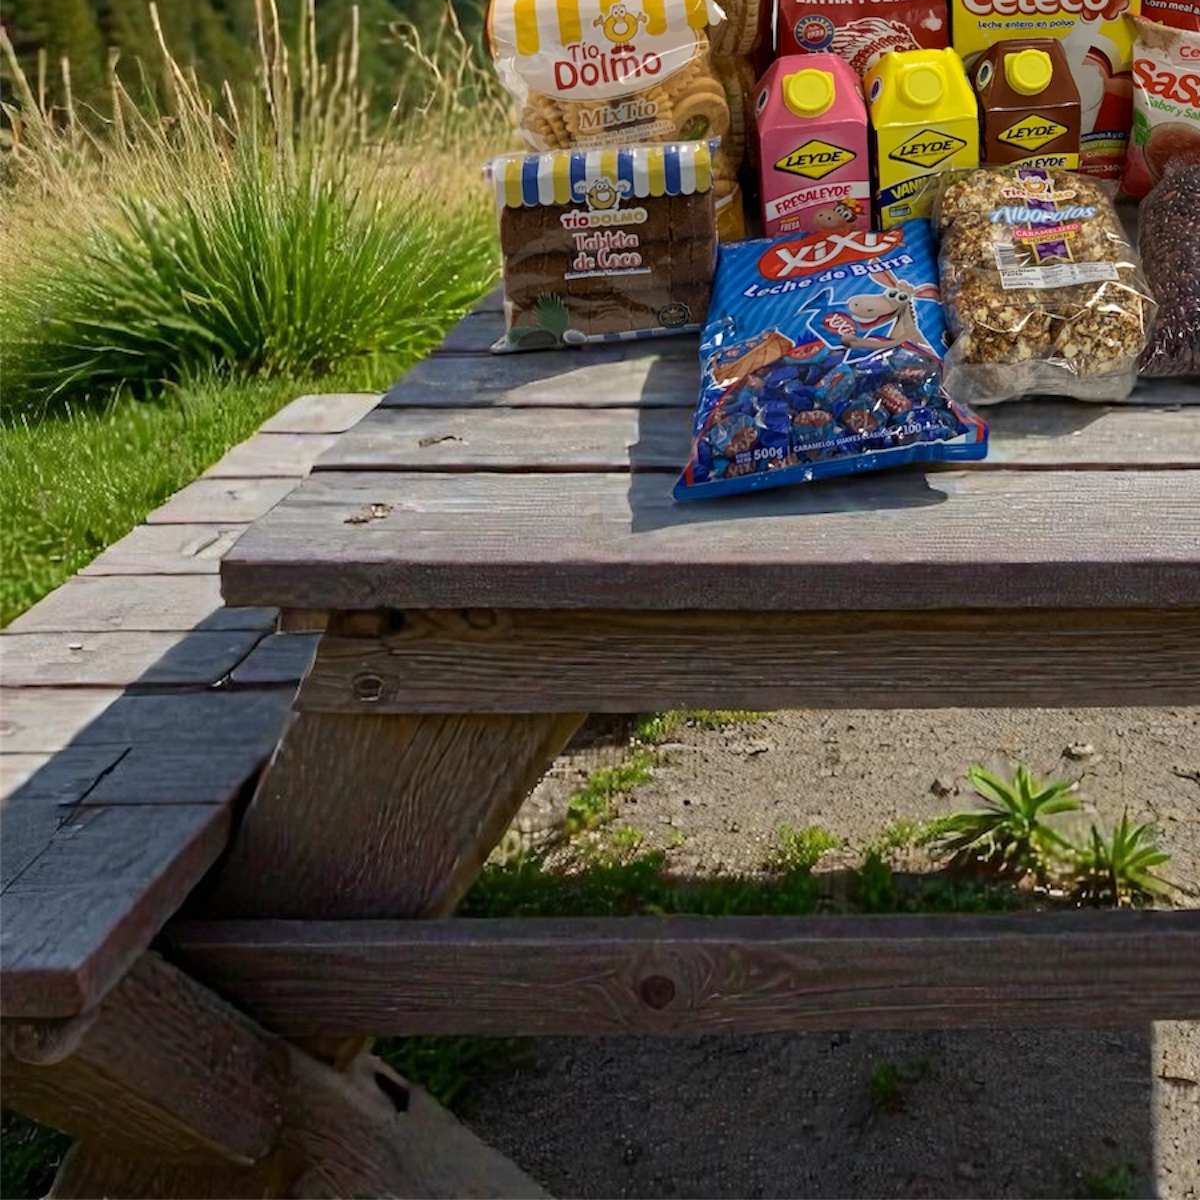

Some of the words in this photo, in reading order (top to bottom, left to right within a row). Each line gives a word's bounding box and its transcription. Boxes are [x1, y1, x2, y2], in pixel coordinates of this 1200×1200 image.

[1168, 0, 1194, 13] meal
[1050, 19, 1075, 29] polvo
[567, 42, 599, 63] Tío
[554, 51, 662, 91] Dolmo
[1145, 95, 1176, 114] Sabor
[1175, 106, 1183, 117] y
[1006, 124, 1058, 140] LEYDE
[899, 140, 954, 157] LEYDE
[785, 151, 843, 168] LEYDE
[775, 185, 852, 215] FRESALEYDE
[990, 205, 1097, 225] Alborotos
[780, 221, 801, 232] FRESA
[1016, 223, 1079, 237] CARAMELIZED
[572, 230, 639, 251] Tableta
[1027, 233, 1071, 243] POPCORN
[573, 253, 595, 271] de
[598, 247, 643, 269] Coco
[744, 279, 812, 298] Leche
[819, 270, 847, 282] de
[852, 253, 914, 277] Burra
[902, 423, 922, 437] 100
[793, 440, 835, 453] CARAMELOS
[836, 434, 861, 447] SUAVES
[753, 446, 784, 462] 500g
